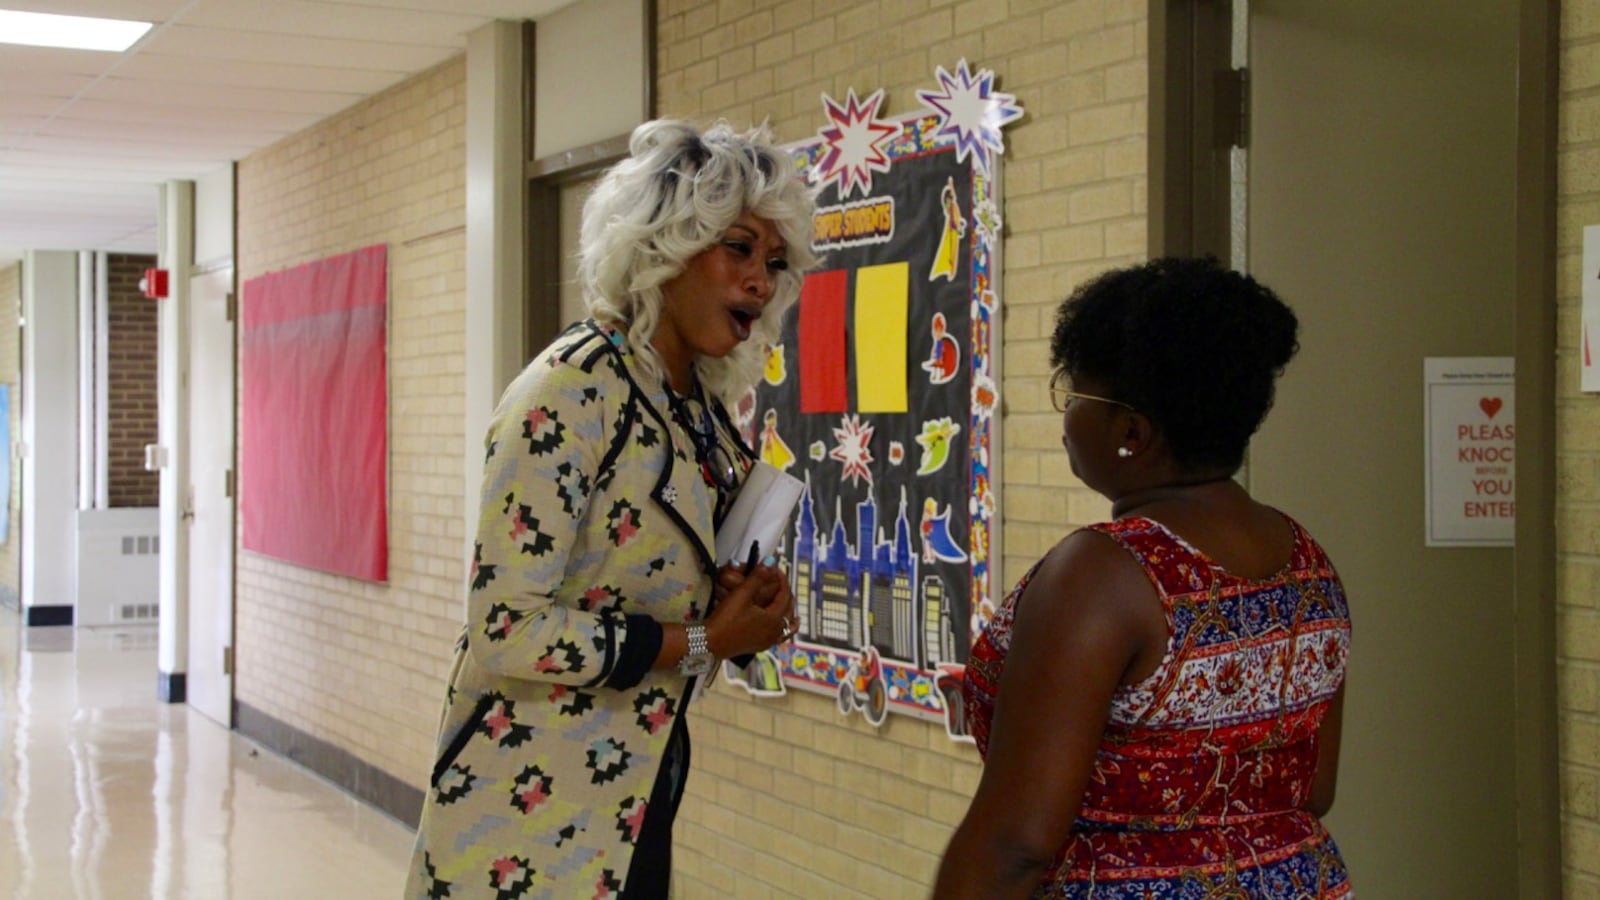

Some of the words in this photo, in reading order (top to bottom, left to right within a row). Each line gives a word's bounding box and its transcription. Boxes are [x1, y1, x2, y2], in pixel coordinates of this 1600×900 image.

[843, 202, 892, 240] STUDENTS
[1458, 424, 1515, 440] PLEAS
[1458, 447, 1515, 461] KNOC
[1472, 480, 1512, 495] YOU
